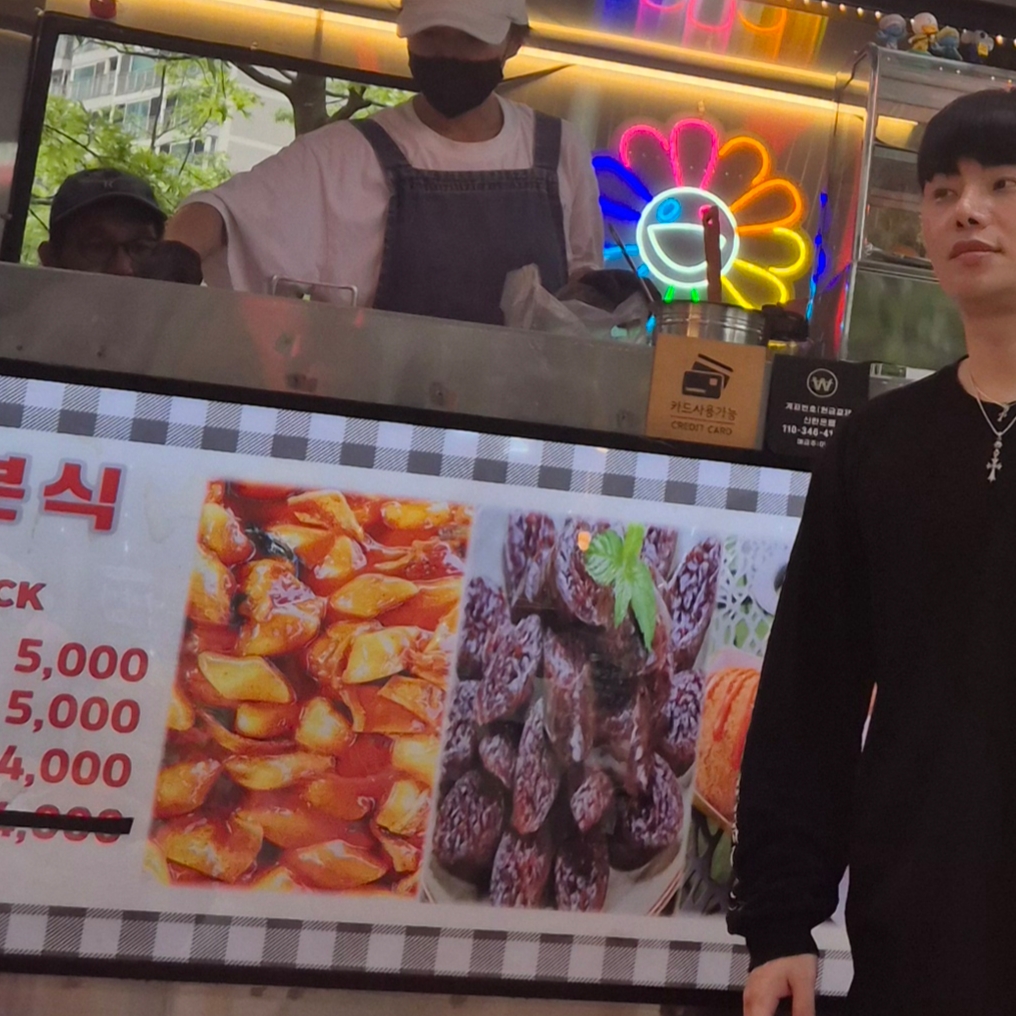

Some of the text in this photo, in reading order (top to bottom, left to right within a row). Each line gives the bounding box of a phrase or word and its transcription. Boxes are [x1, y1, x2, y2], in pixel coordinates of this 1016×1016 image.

[671, 420, 733, 436] CREDIT CARD
[14, 637, 149, 682] 5,000
[5, 689, 141, 734] 5,000
[0, 745, 132, 788] 4,000
